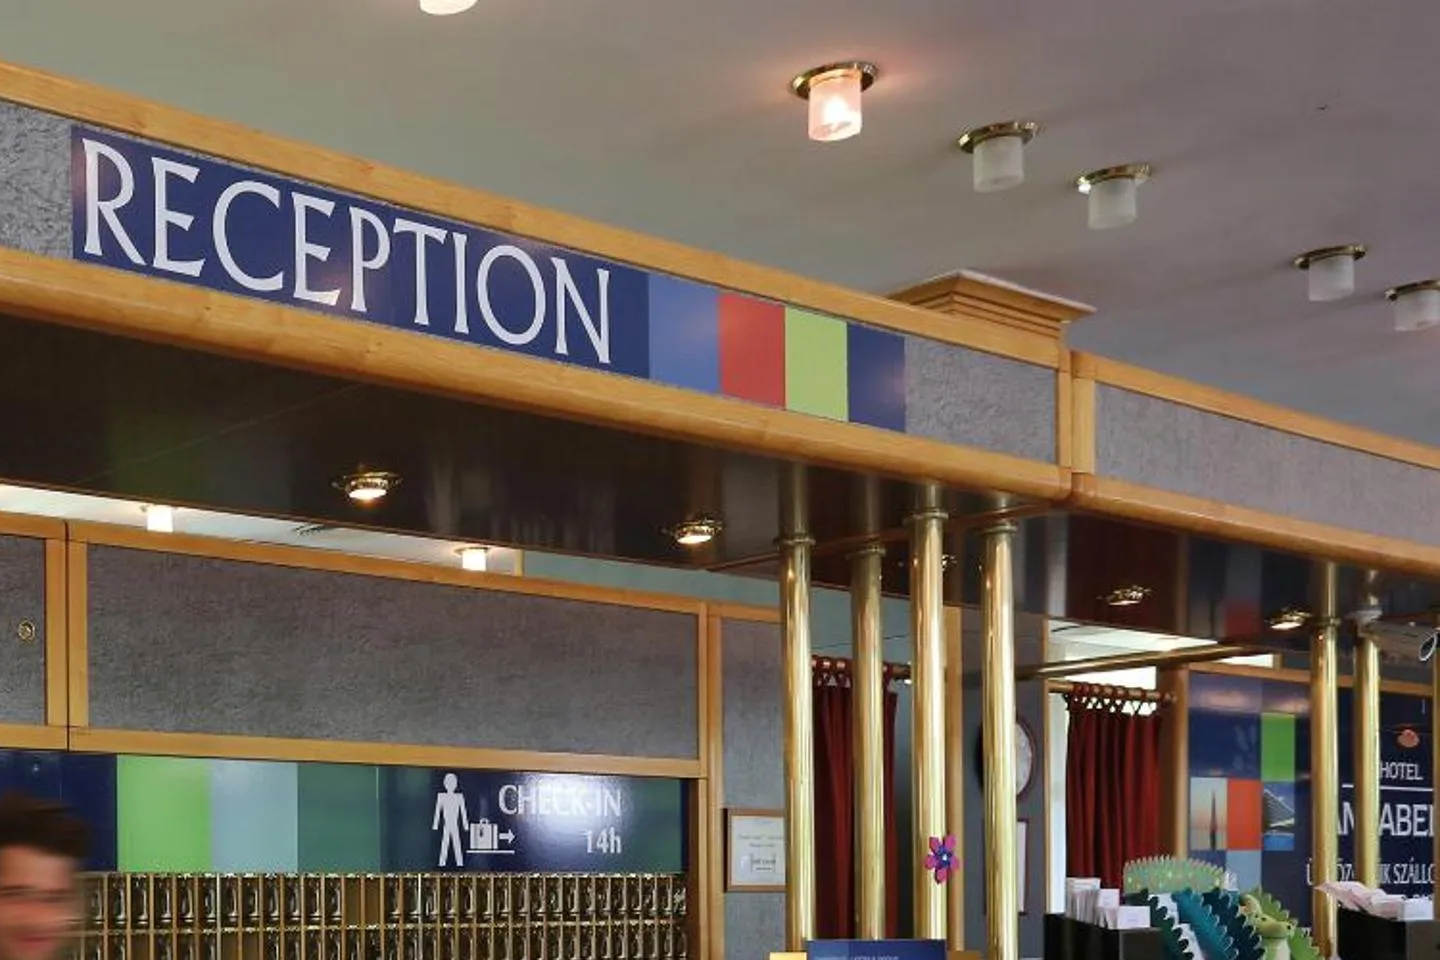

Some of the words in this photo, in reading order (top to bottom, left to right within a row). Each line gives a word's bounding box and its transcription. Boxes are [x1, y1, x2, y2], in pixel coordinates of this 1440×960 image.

[80, 137, 611, 364] RECEPTION
[1380, 762, 1423, 780] HOTEL
[498, 784, 621, 818] CHECK-IN
[582, 826, 621, 854] 14h
